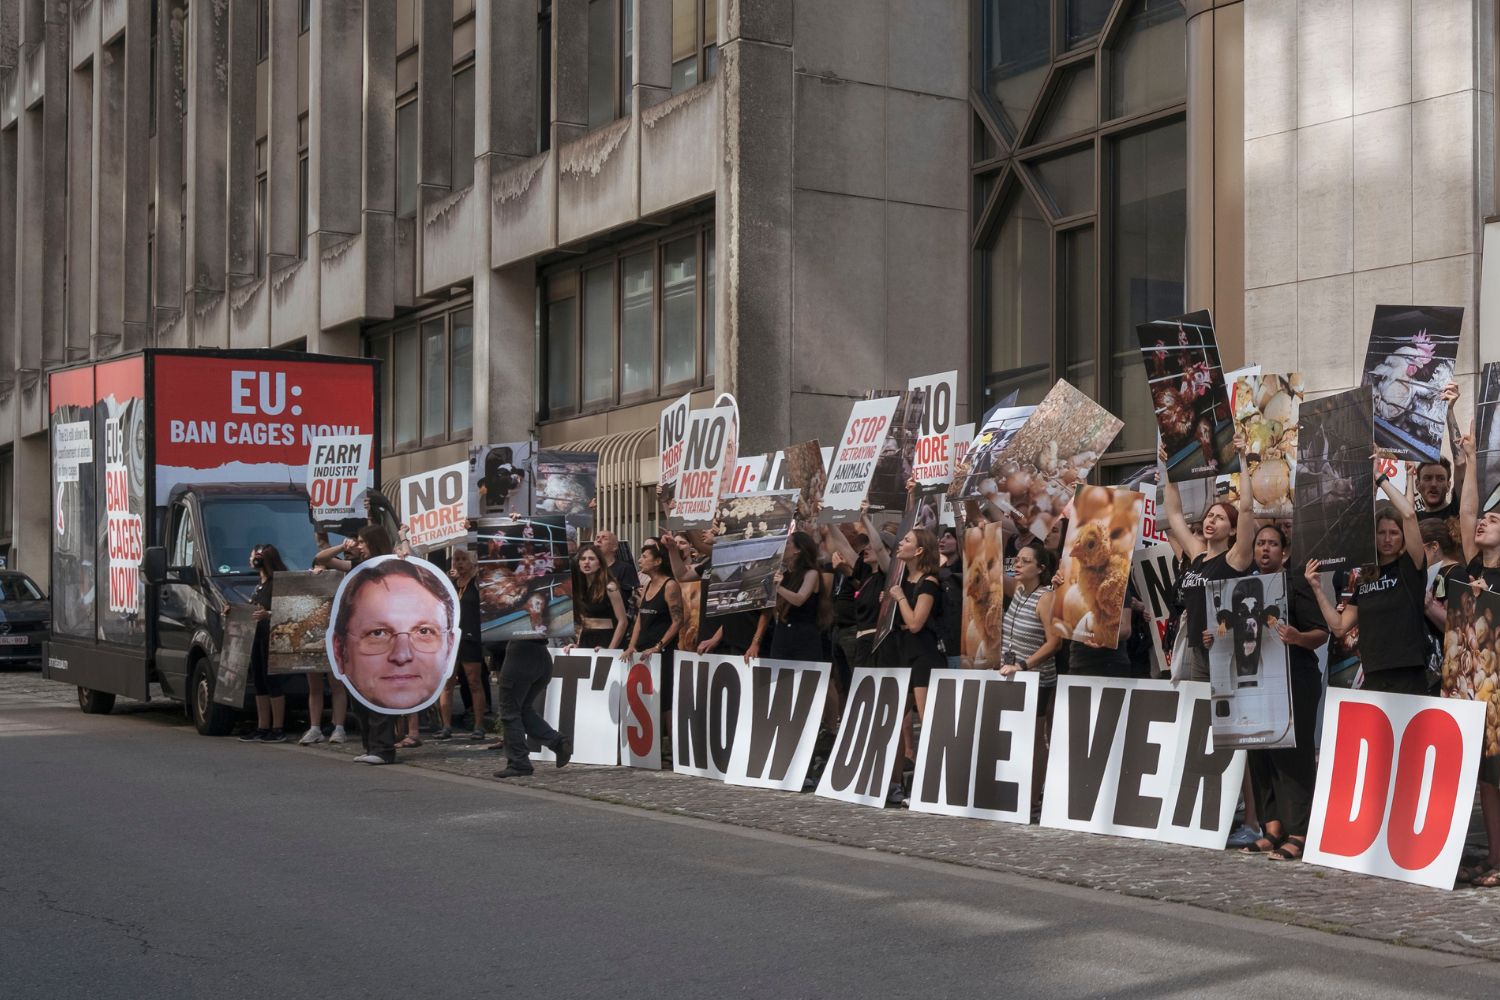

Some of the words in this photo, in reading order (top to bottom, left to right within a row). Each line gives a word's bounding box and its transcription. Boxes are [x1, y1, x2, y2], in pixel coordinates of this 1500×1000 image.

[231, 370, 302, 416] EU:
[914, 381, 951, 437] NO
[170, 420, 217, 444] BAN
[223, 421, 295, 446] CAGES
[663, 403, 686, 452] NO
[846, 415, 887, 446] STOP
[315, 443, 362, 465] FARM
[683, 416, 726, 471] NO
[839, 445, 878, 462] BETRAYING
[955, 441, 970, 462] TOP
[313, 465, 359, 478] INDUSTRY
[680, 470, 718, 500] MORE
[833, 461, 871, 481] ANIMALS
[912, 463, 949, 481] BETRAYALS
[106, 469, 128, 512] BAN
[310, 477, 359, 508] OUT
[408, 470, 463, 516] NO
[409, 502, 465, 535] MORE
[675, 500, 712, 515] BETRAYALS
[108, 518, 142, 561] CAGES
[411, 520, 466, 546] BETRAYALS
[110, 566, 139, 609] NOW!
[1181, 577, 1209, 589] UALITY
[1359, 577, 1398, 595] EQUALITY
[527, 656, 653, 758] T'S
[678, 660, 822, 781] NOW
[831, 675, 899, 798] OR
[1319, 700, 1464, 871] DO
